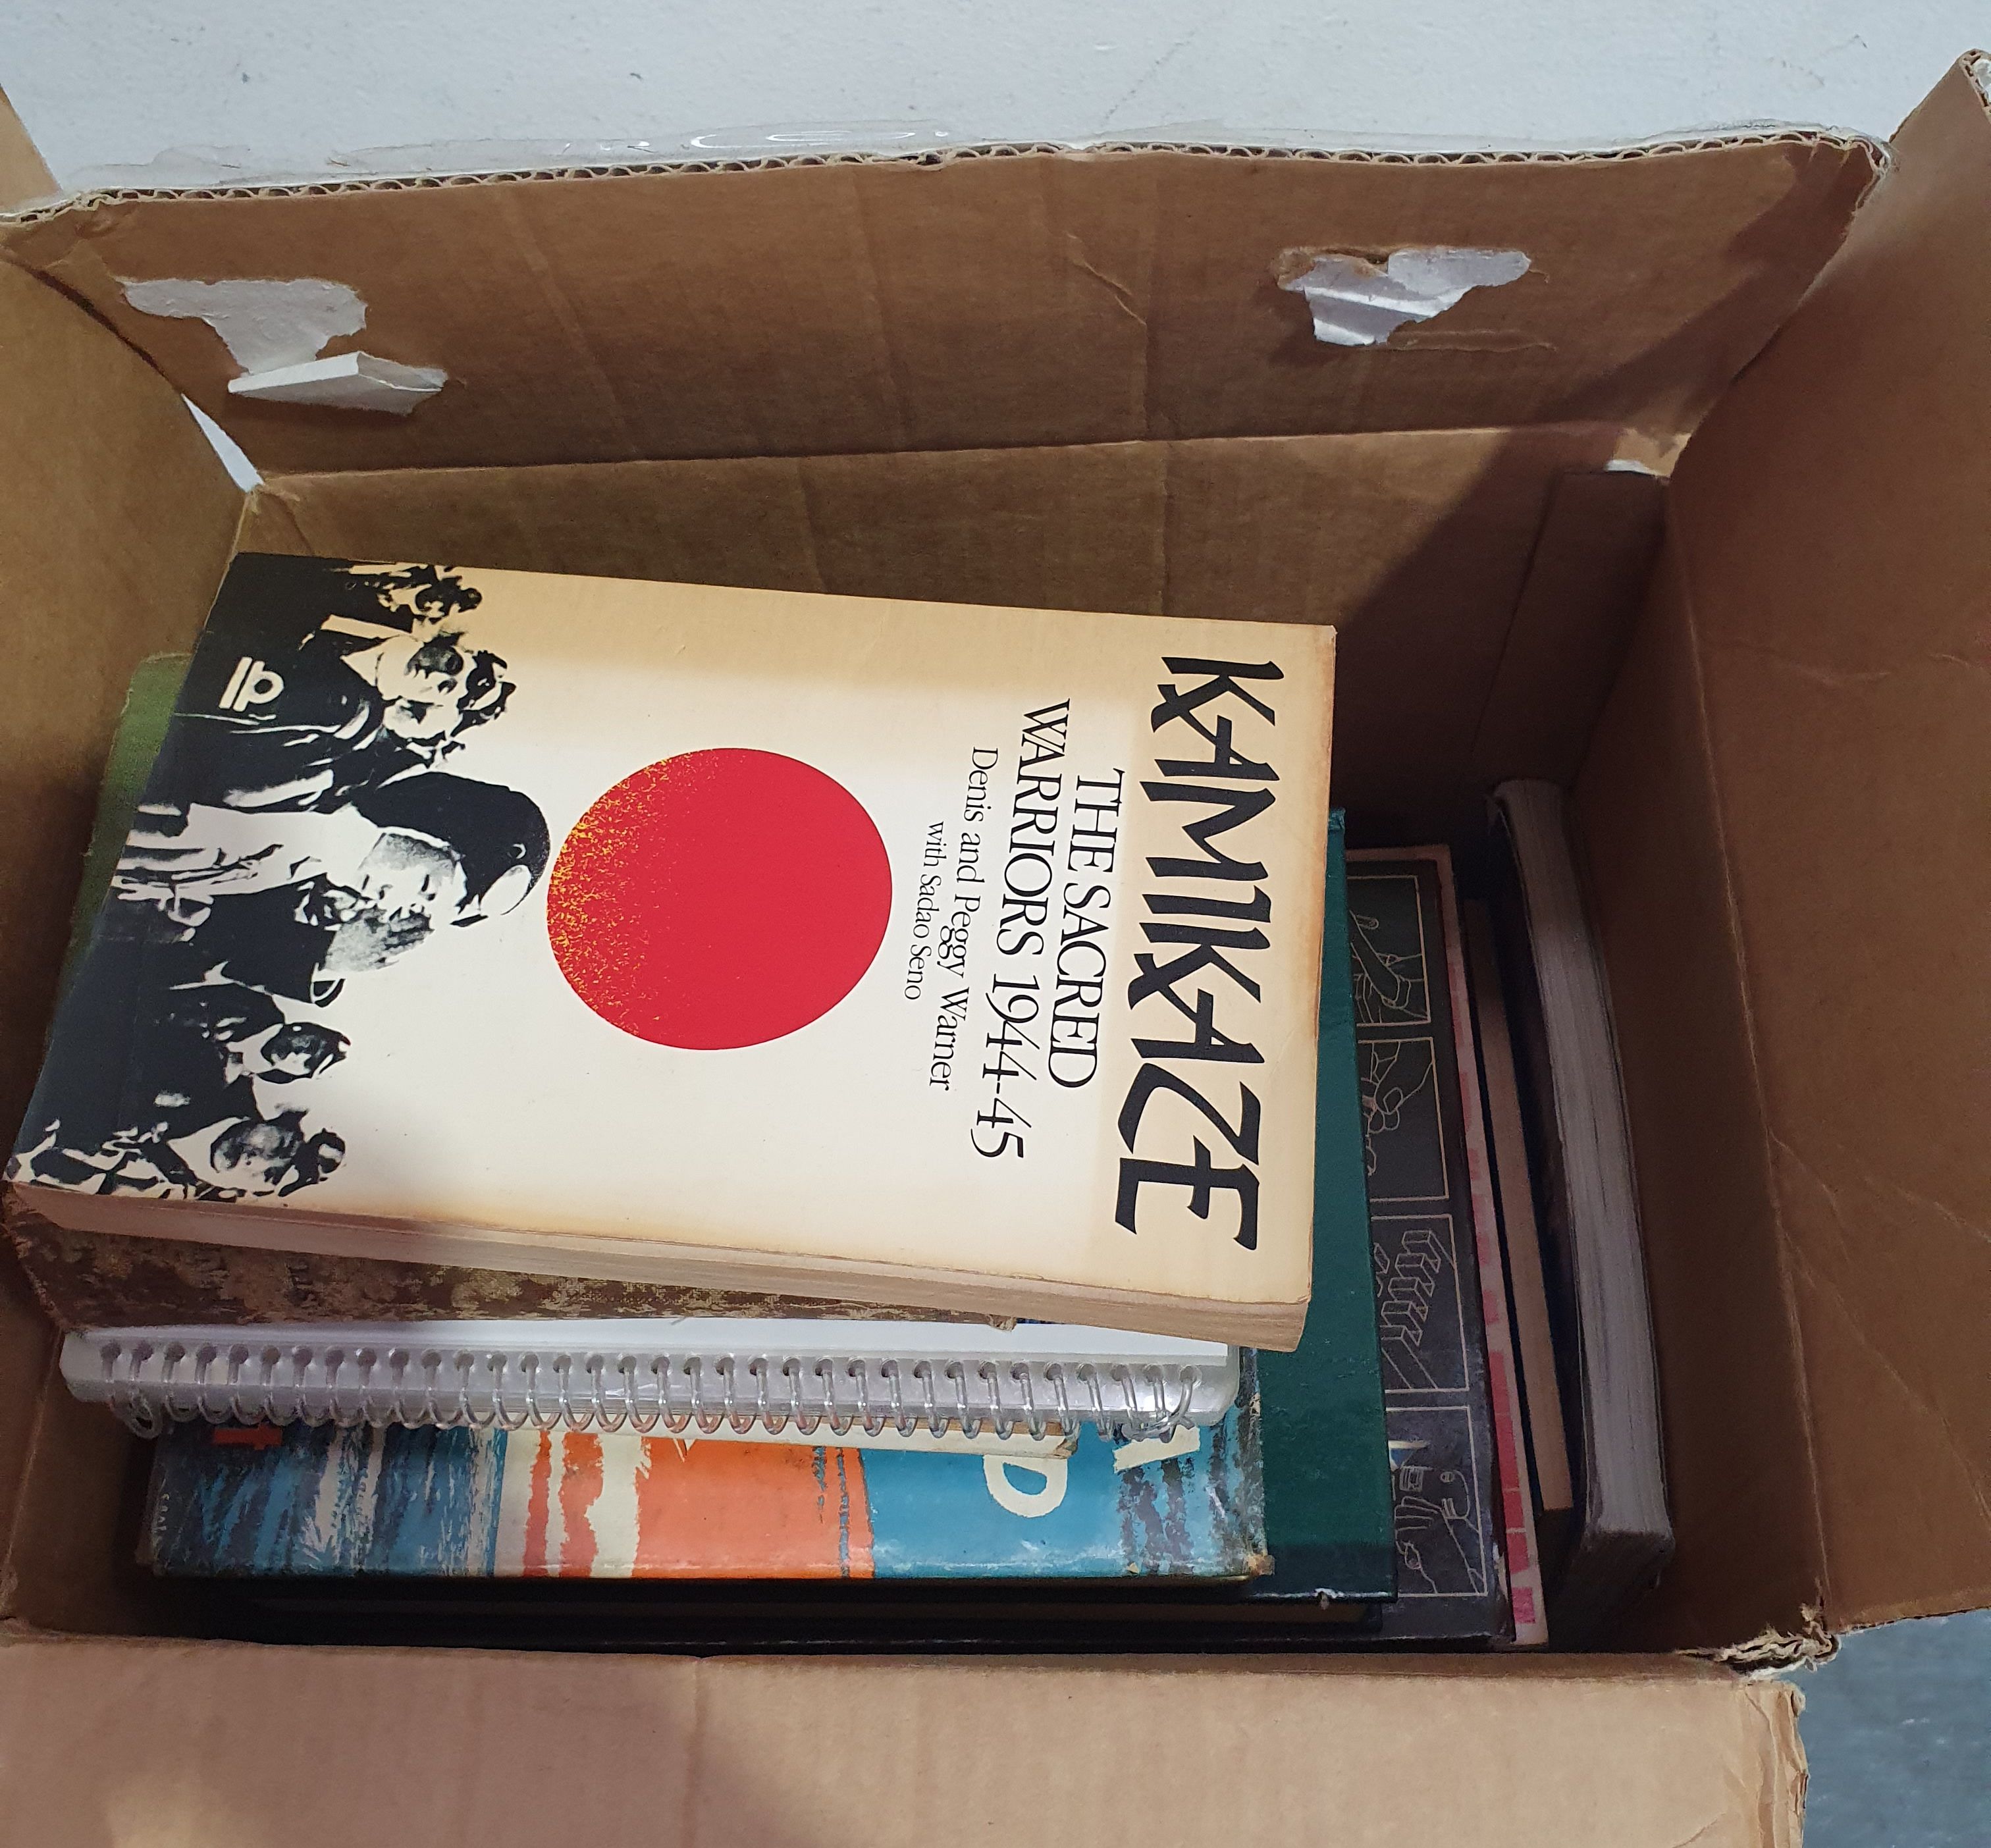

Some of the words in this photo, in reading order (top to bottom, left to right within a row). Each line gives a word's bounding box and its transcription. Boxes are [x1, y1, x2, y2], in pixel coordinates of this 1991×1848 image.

[963, 746, 999, 822] Denis
[996, 697, 1071, 956] WARRIORS
[1067, 767, 1126, 874] THE
[922, 820, 947, 867] with
[955, 832, 986, 884] and
[913, 873, 942, 939] Sadao
[936, 893, 982, 979] Peggy
[1114, 656, 1285, 1252] KAMIKAZE
[903, 943, 932, 1001] Seno
[1048, 882, 1112, 1089] SACRED
[928, 986, 970, 1092] Warner
[970, 972, 1041, 1159] 1944-45
